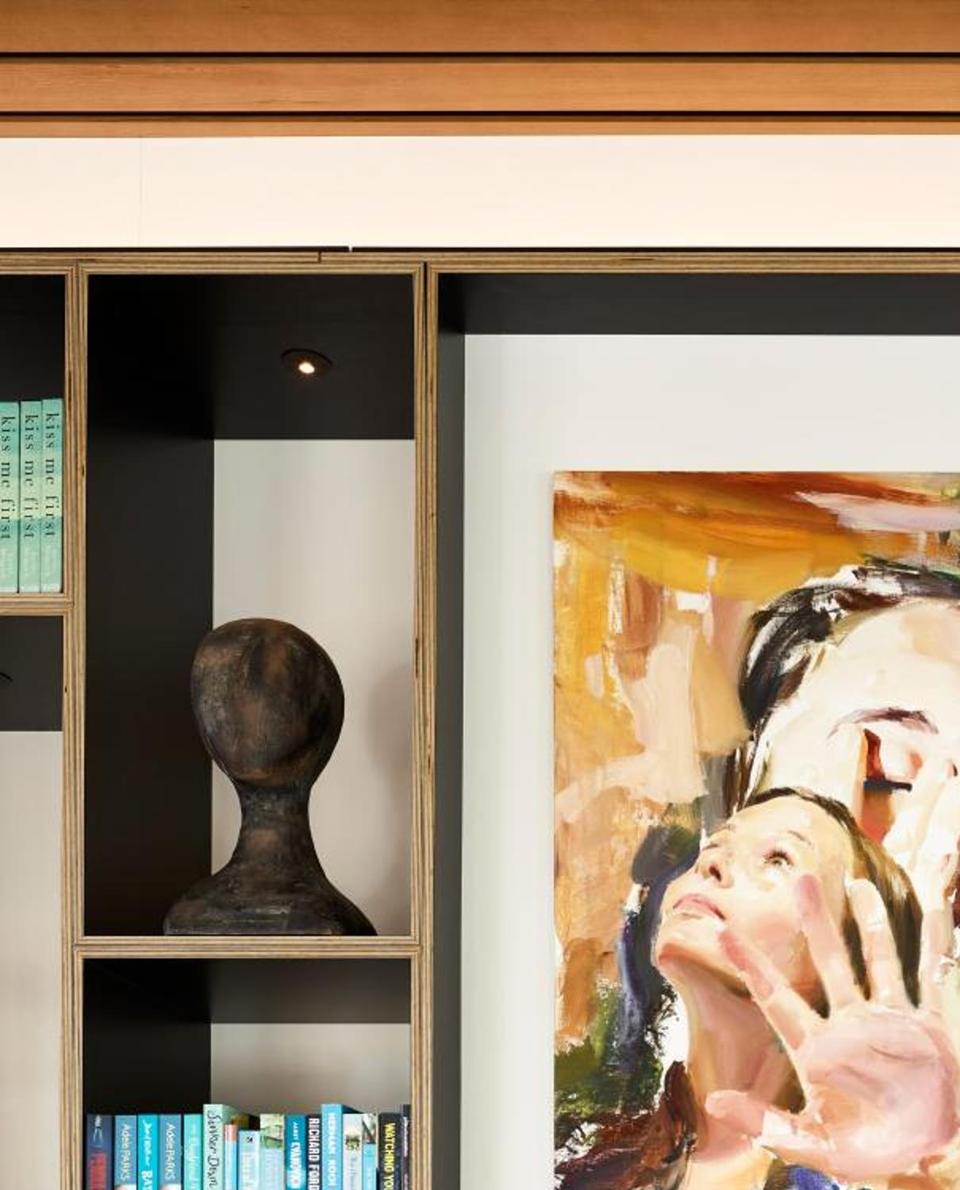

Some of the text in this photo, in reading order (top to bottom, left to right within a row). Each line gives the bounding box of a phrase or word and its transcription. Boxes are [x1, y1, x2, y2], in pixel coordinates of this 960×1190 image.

[1, 416, 16, 452] kiss
[25, 415, 39, 451] kiss
[45, 413, 60, 449] kiss
[1, 462, 11, 488] me
[25, 460, 35, 487] me
[45, 459, 55, 485] me
[1, 499, 16, 540] first
[24, 497, 39, 538] first
[45, 495, 60, 537] first
[308, 1117, 320, 1162] RICHARD
[384, 1122, 396, 1173] WATCHING
[165, 1150, 176, 1180] PARKS
